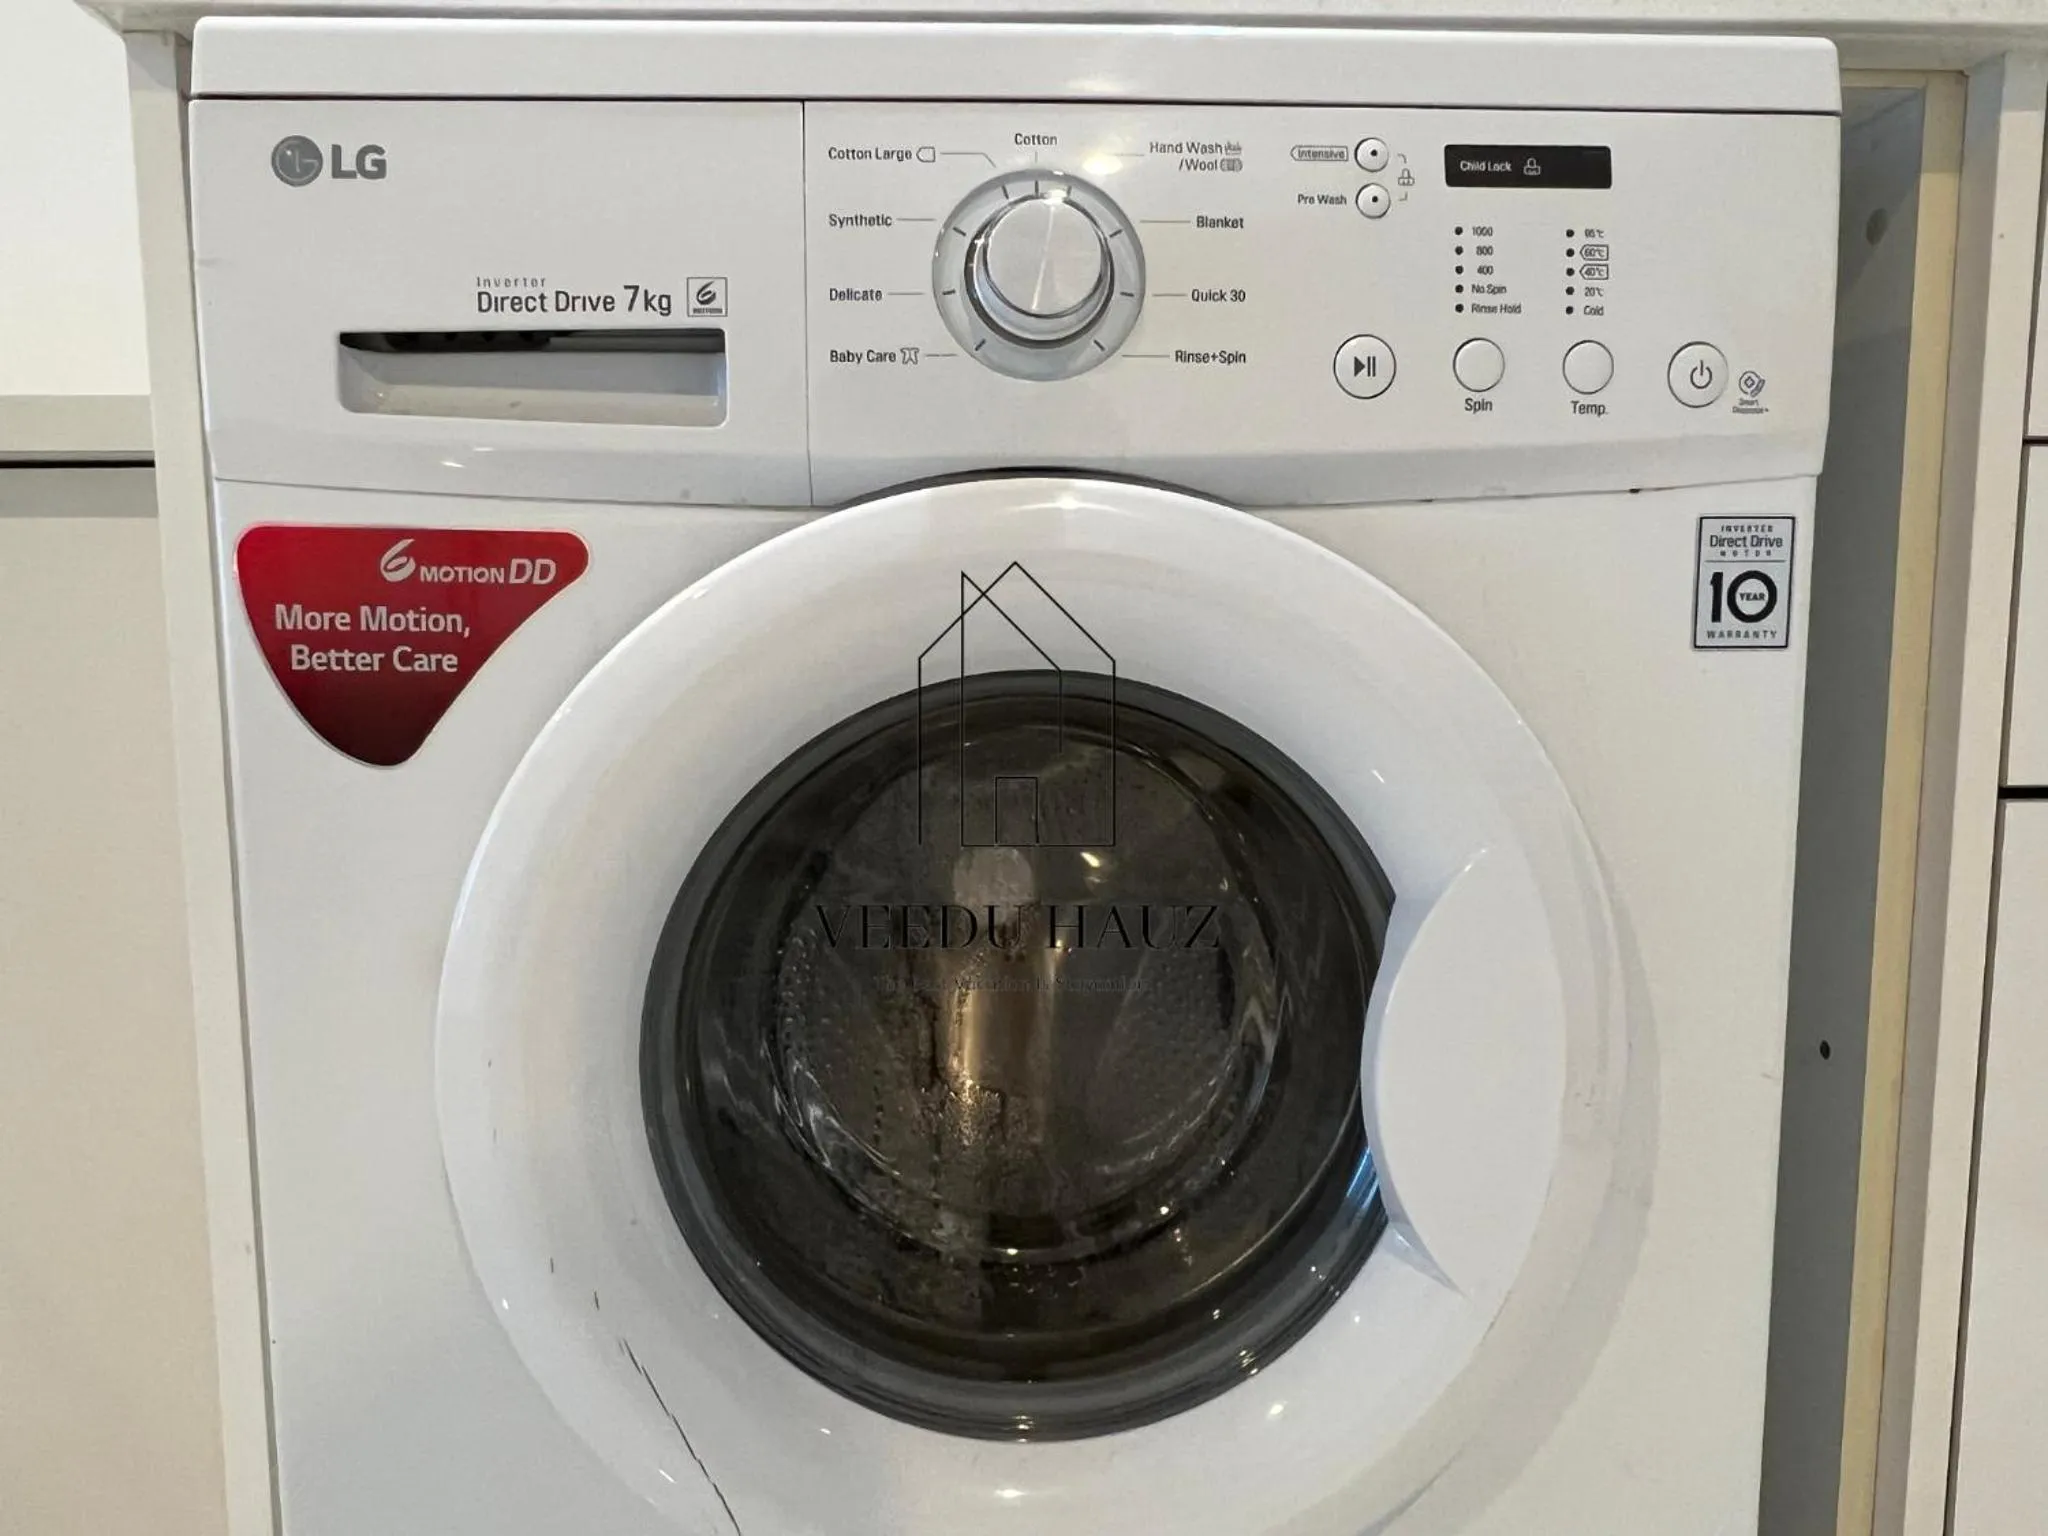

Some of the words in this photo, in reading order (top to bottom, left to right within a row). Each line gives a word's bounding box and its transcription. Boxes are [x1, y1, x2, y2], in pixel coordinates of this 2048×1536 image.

[1014, 132, 1058, 147] Cotton
[828, 146, 872, 161] Cotton
[875, 147, 913, 163] Large
[1149, 141, 1184, 154] Hand
[1186, 141, 1223, 155] Wash
[1298, 149, 1346, 159] Intensive
[330, 142, 388, 181] LG
[1178, 158, 1219, 172] /Wool
[1460, 160, 1486, 172] Child
[1487, 160, 1512, 174] Lock
[1297, 193, 1316, 205] Pre
[1317, 194, 1348, 206] Wash
[828, 213, 893, 229] Synthetic
[1195, 215, 1245, 231] Blanket
[1472, 226, 1493, 237] 1000
[1475, 245, 1494, 256] 800
[1477, 265, 1494, 275] 400
[476, 275, 547, 289] Inverter
[1471, 283, 1485, 294] No
[1486, 283, 1507, 295] Spin
[476, 288, 549, 314] Direct
[554, 288, 616, 313] Drive
[828, 287, 883, 302] Delicate
[1189, 287, 1228, 303] Quick
[1229, 288, 1247, 302] 30
[1471, 303, 1498, 314] Rinse
[1499, 303, 1522, 314] Hold
[1583, 305, 1605, 316] Cold
[829, 349, 863, 365] Baby
[865, 349, 897, 364] Care
[1174, 349, 1247, 366] Rinse+Spin
[1463, 396, 1494, 415] Spin
[1570, 400, 1609, 417] Temp.
[1720, 524, 1774, 533] INVERTER
[1709, 534, 1747, 548] Direct
[1750, 534, 1783, 548] Drive
[419, 567, 506, 584] MOTION
[508, 557, 558, 585] DD
[1710, 570, 1778, 624] 10
[1739, 592, 1767, 602] YEAR
[274, 603, 352, 632] More
[358, 604, 471, 639] Motion,
[1706, 629, 1778, 640] WARRANTY
[289, 643, 386, 673] Better
[392, 645, 459, 674] Care
